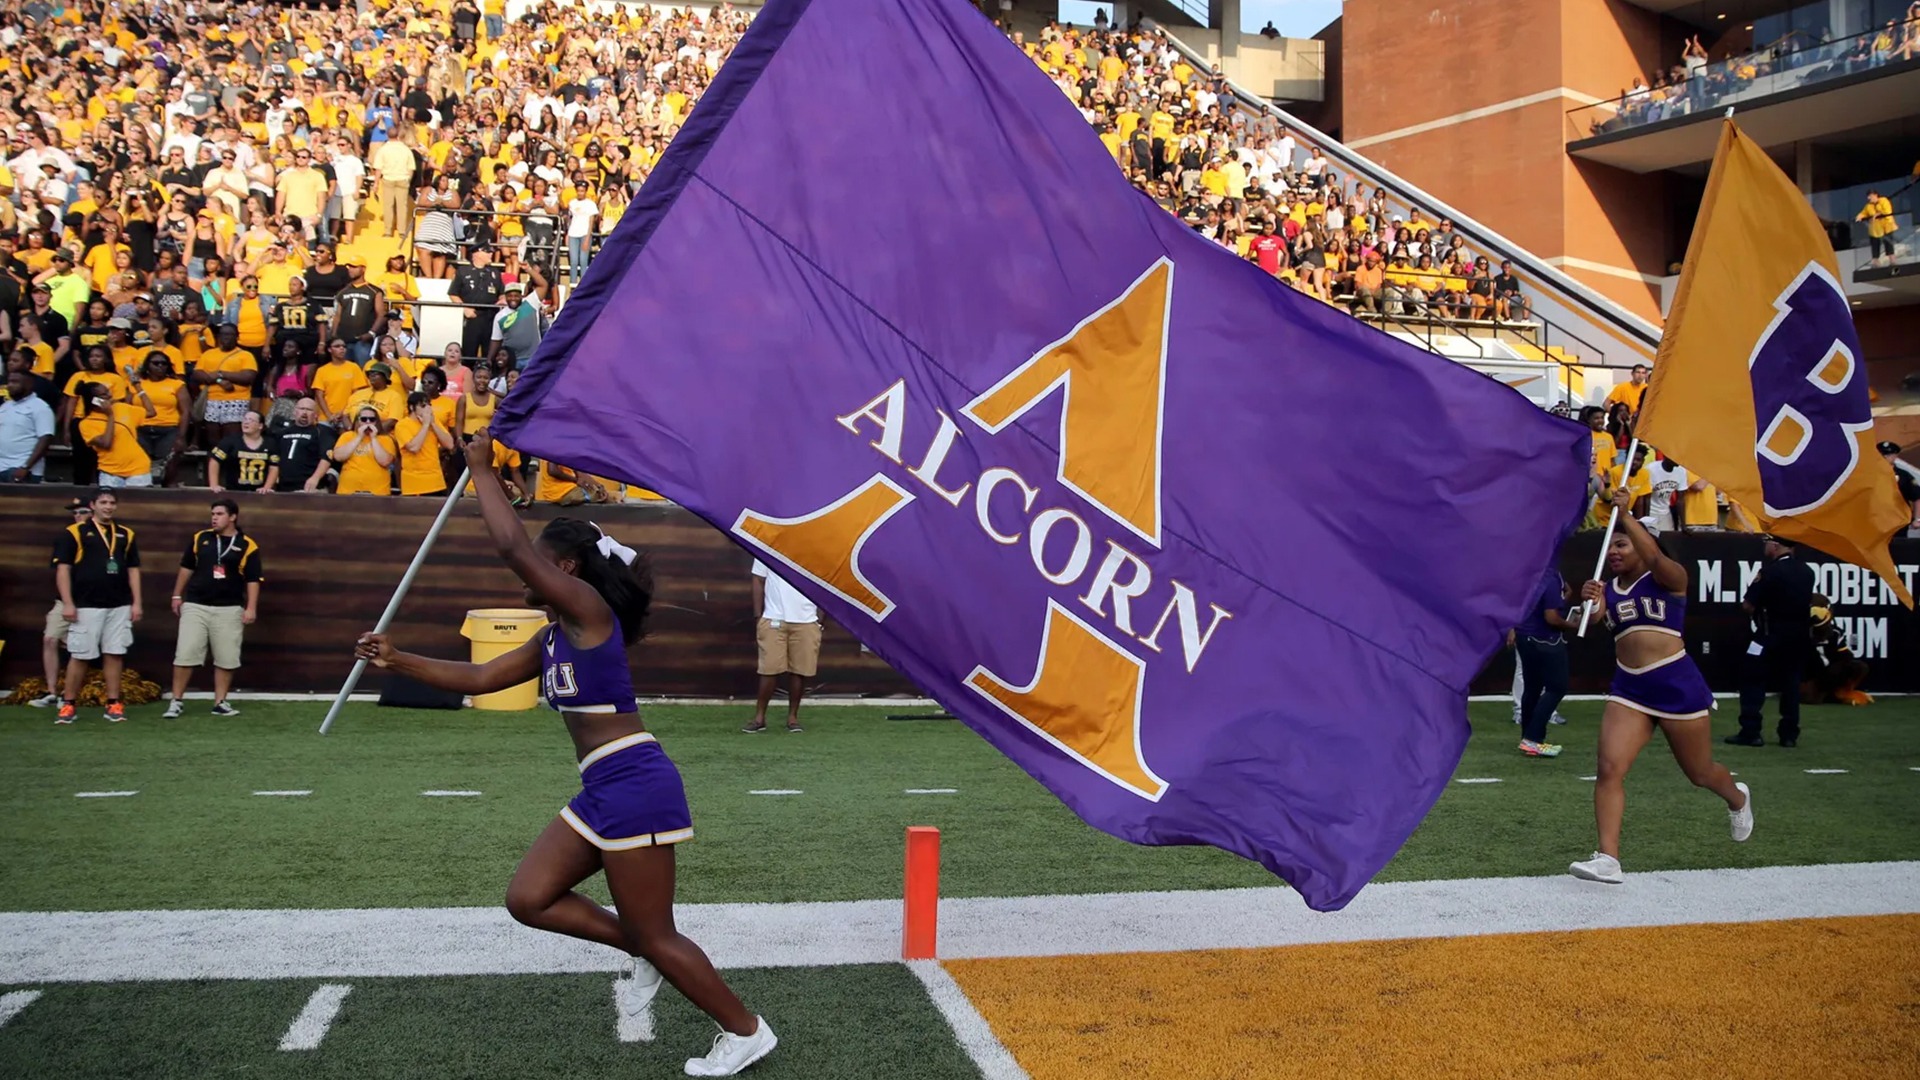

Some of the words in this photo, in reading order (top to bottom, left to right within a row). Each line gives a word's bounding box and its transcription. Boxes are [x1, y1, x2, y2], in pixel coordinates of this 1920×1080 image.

[730, 255, 1174, 803] A
[835, 378, 1233, 675] ALCORN
[1748, 260, 1874, 518] B
